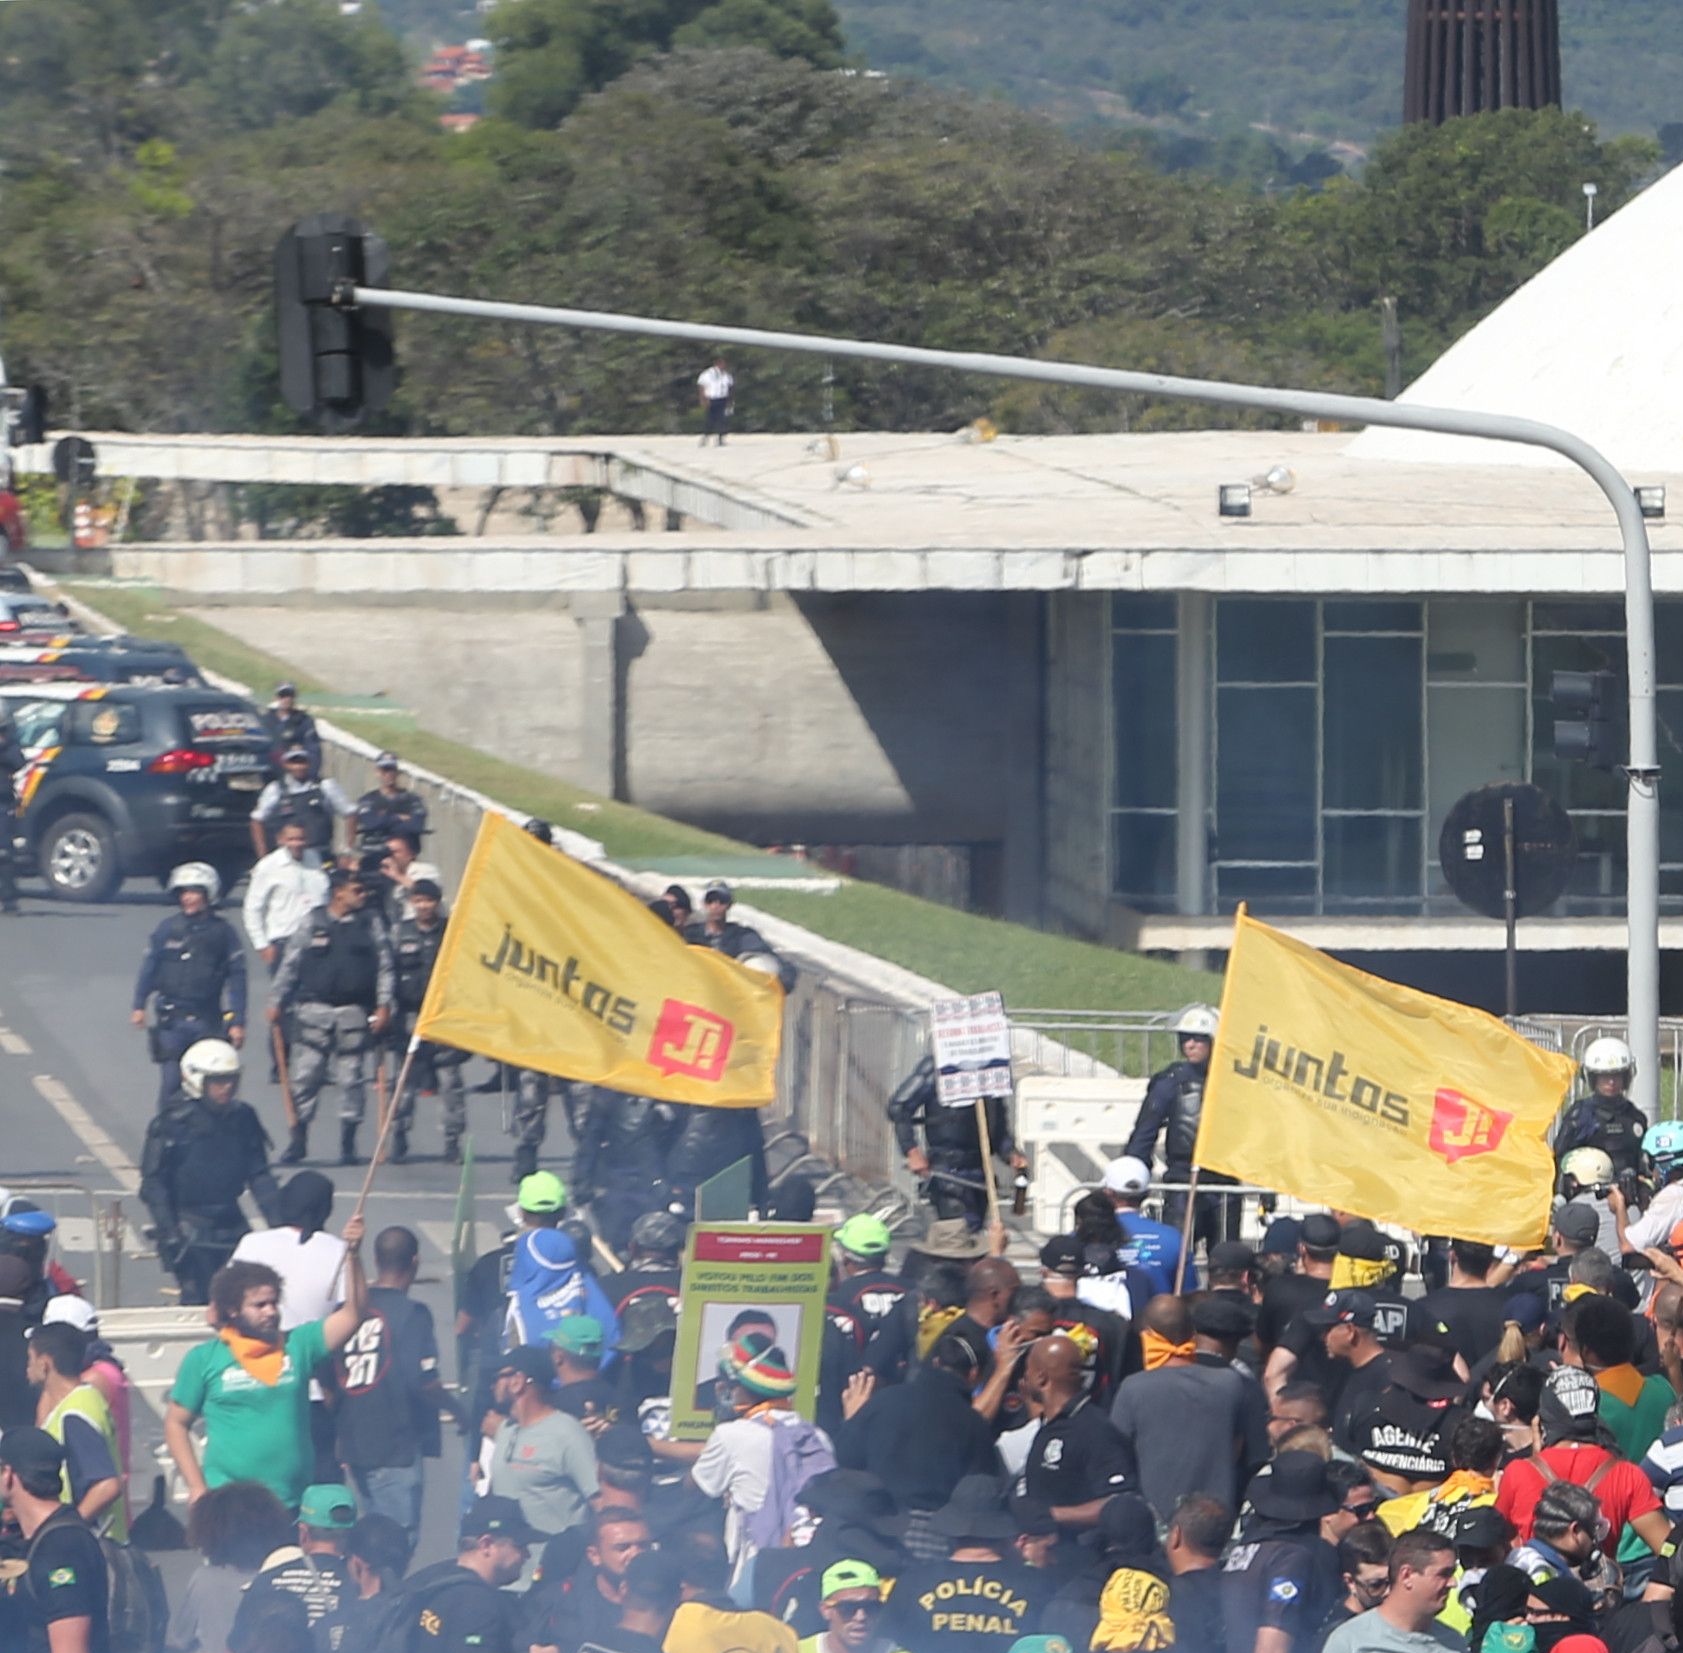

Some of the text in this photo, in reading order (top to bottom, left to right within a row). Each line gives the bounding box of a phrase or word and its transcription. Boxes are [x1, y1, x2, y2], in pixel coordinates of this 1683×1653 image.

[481, 922, 638, 1035] juntos
[1233, 1024, 1410, 1128] juntos
[918, 1575, 1028, 1618] POLÍCIA
[932, 1613, 1020, 1635] PENAL
